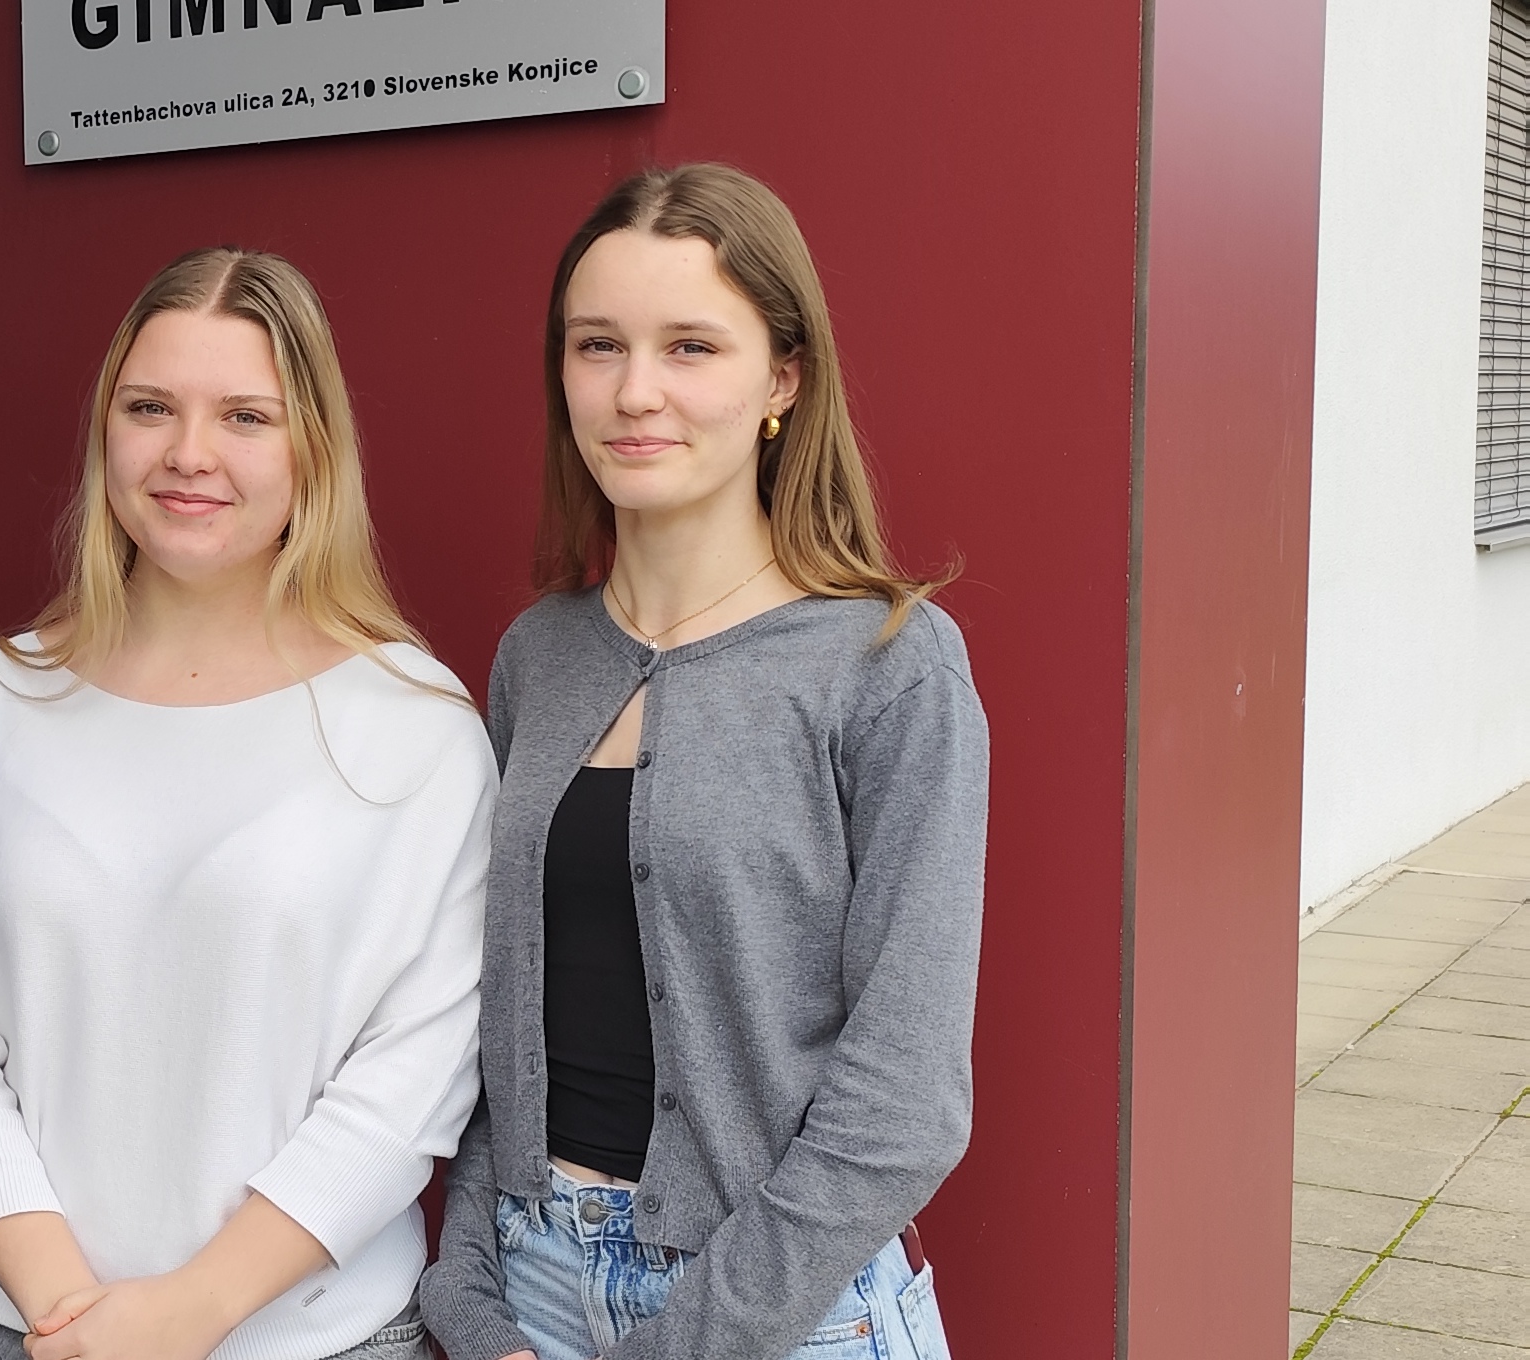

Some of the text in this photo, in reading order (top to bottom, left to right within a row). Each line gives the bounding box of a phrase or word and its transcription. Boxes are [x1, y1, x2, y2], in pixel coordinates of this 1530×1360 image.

[71, 56, 599, 128] Tattenbachova ulica 2A, 3210 Slovenske Konjice
